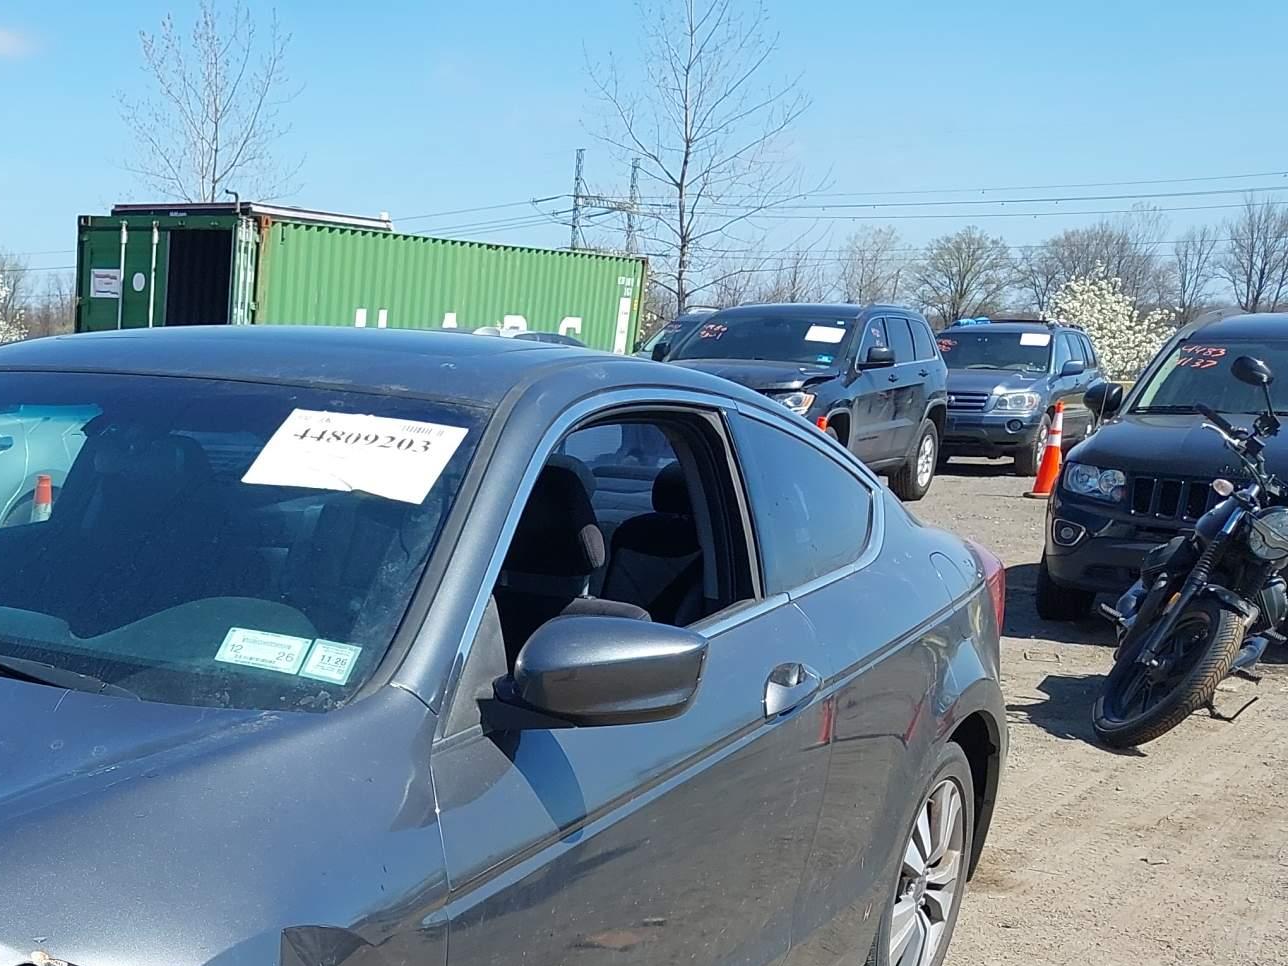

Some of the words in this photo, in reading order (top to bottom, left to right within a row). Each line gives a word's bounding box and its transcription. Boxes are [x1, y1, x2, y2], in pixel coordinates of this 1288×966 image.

[293, 427, 432, 453] 44809203
[230, 643, 244, 654] 12
[275, 651, 294, 663] 26
